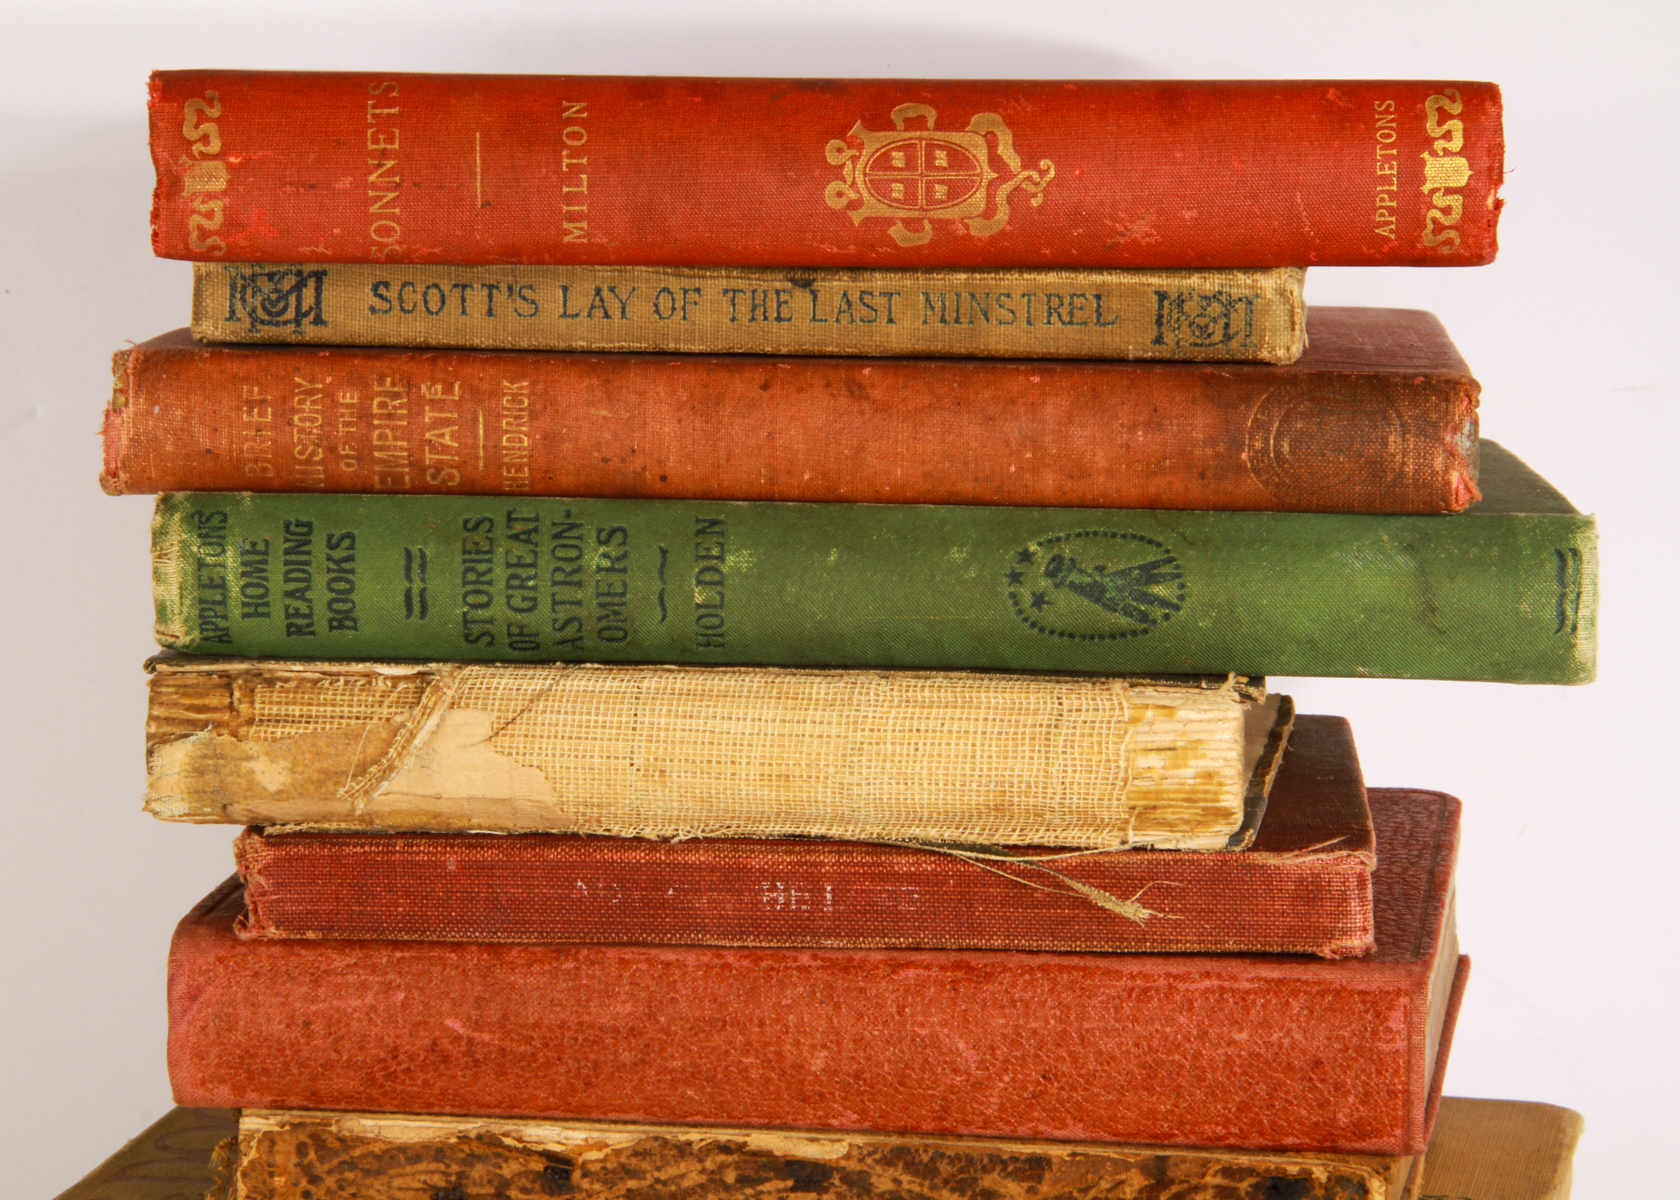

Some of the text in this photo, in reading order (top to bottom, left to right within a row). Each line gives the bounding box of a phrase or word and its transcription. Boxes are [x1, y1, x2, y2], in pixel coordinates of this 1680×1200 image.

[368, 81, 400, 259] SONNETS
[562, 100, 588, 244] MILTON
[1375, 100, 1398, 239] APPLETONS
[369, 280, 539, 318] SCOTT'S
[559, 285, 639, 320] LAY
[653, 287, 702, 321] OF
[722, 288, 793, 323] THE
[808, 289, 900, 325] LAST
[920, 291, 1118, 327] MINSTREL
[242, 385, 274, 477] BRIEF
[293, 377, 324, 487] HISTORY
[339, 391, 358, 471] OF THE
[373, 377, 410, 489] EMPIRE
[426, 381, 460, 487] STATE
[503, 380, 530, 491] HENDRICK
[239, 537, 271, 620] HOME
[283, 518, 316, 638] READING
[326, 531, 358, 633] BOOKS
[462, 515, 495, 648] STORIES
[505, 508, 541, 653] OF GREAT
[551, 508, 585, 653] ASTRON-
[596, 525, 628, 643] OMERS
[694, 516, 725, 648] HOLDEN
